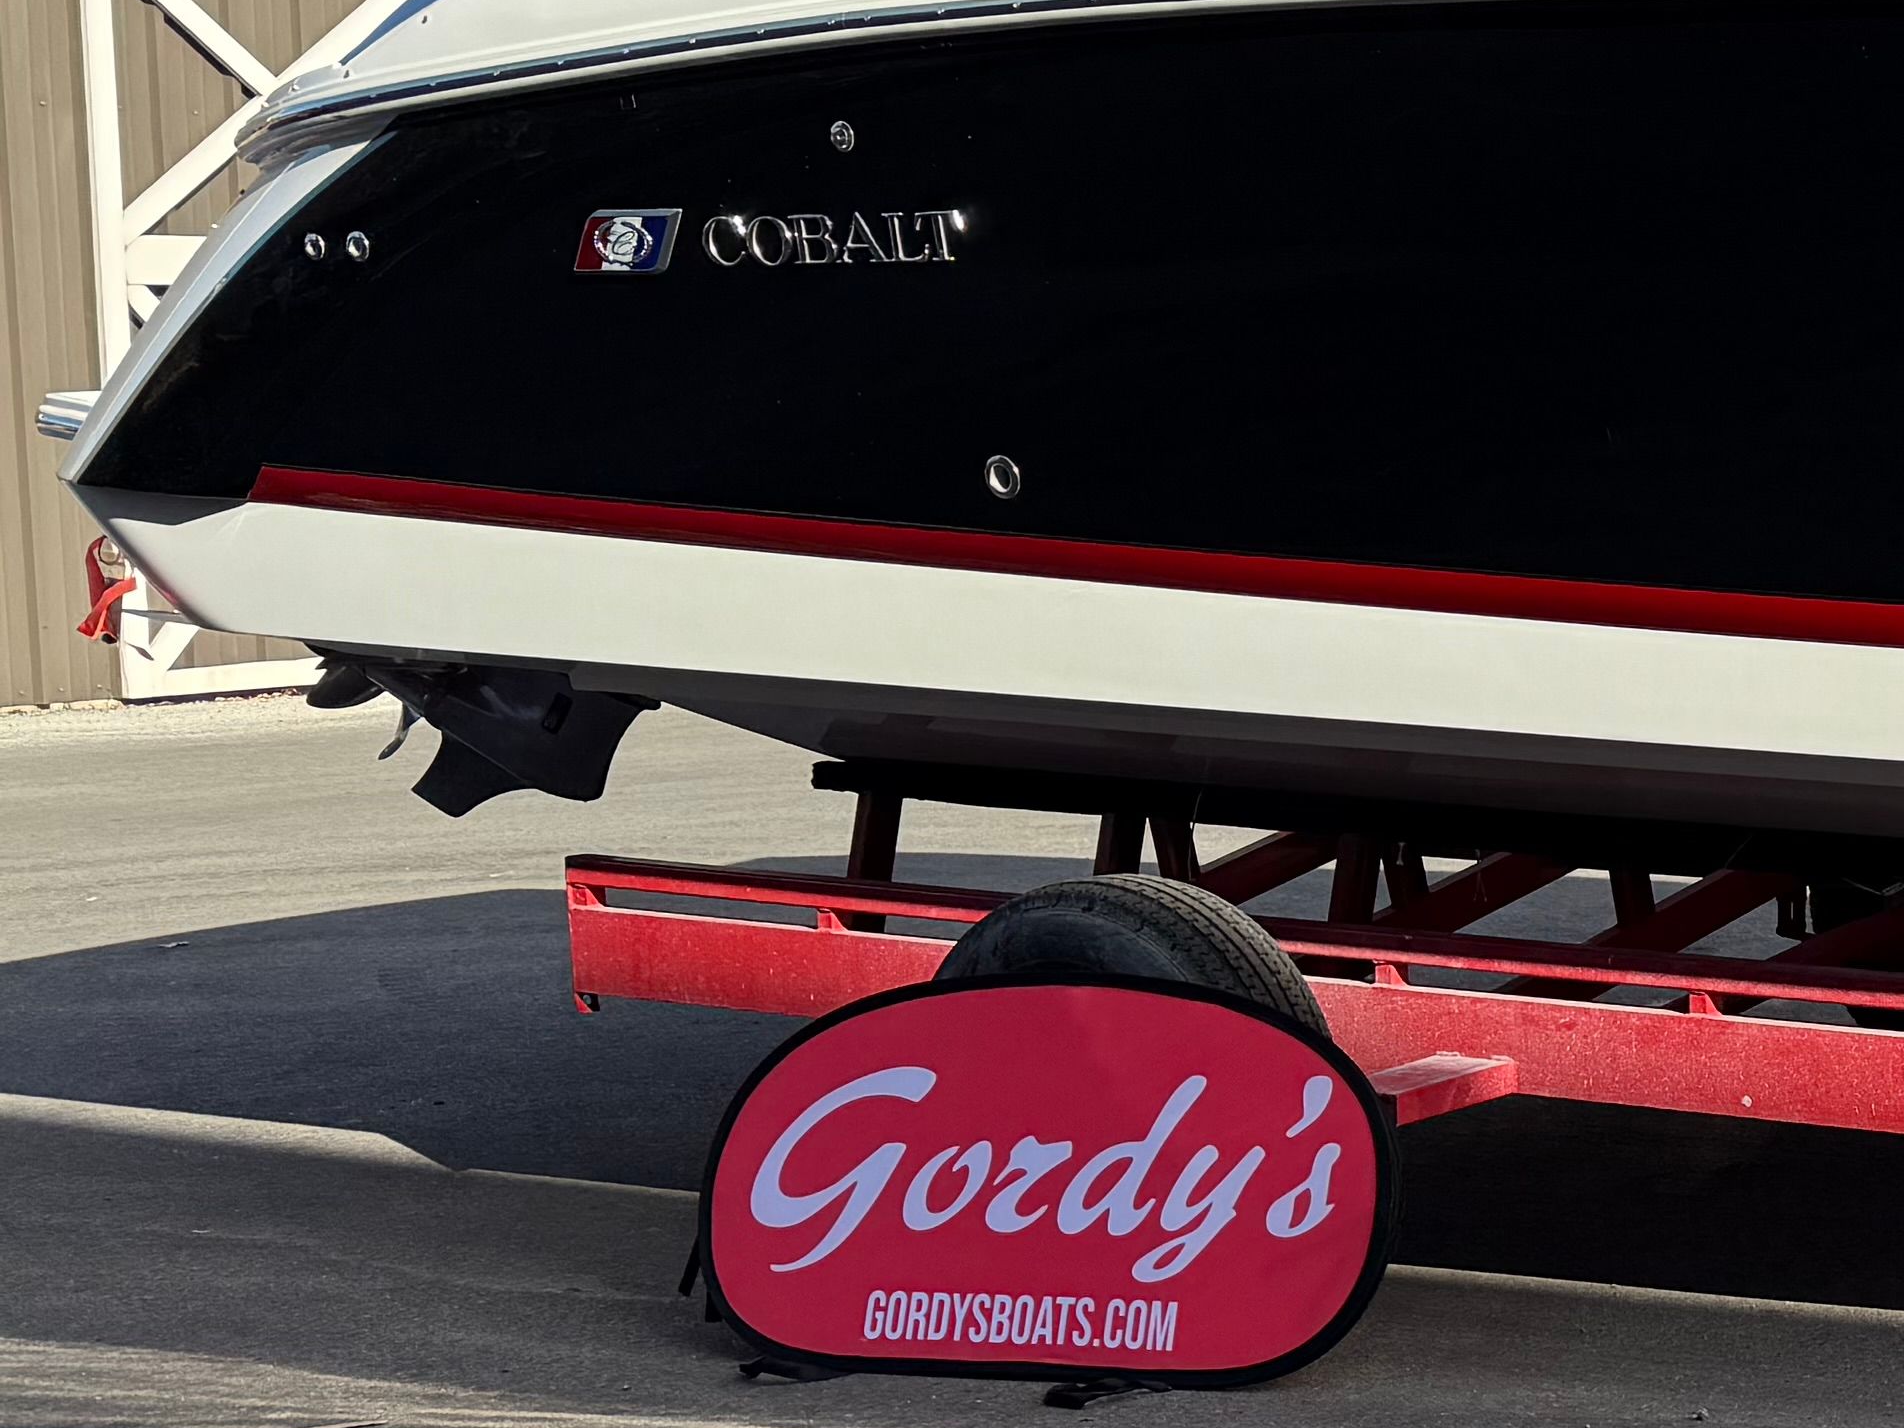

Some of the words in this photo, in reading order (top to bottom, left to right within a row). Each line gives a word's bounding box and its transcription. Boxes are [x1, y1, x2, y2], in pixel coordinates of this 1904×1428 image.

[701, 209, 967, 267] COBALT
[749, 1066, 1342, 1284] Gordy's
[863, 1289, 1179, 1352] GORDYSBOATS.COM
